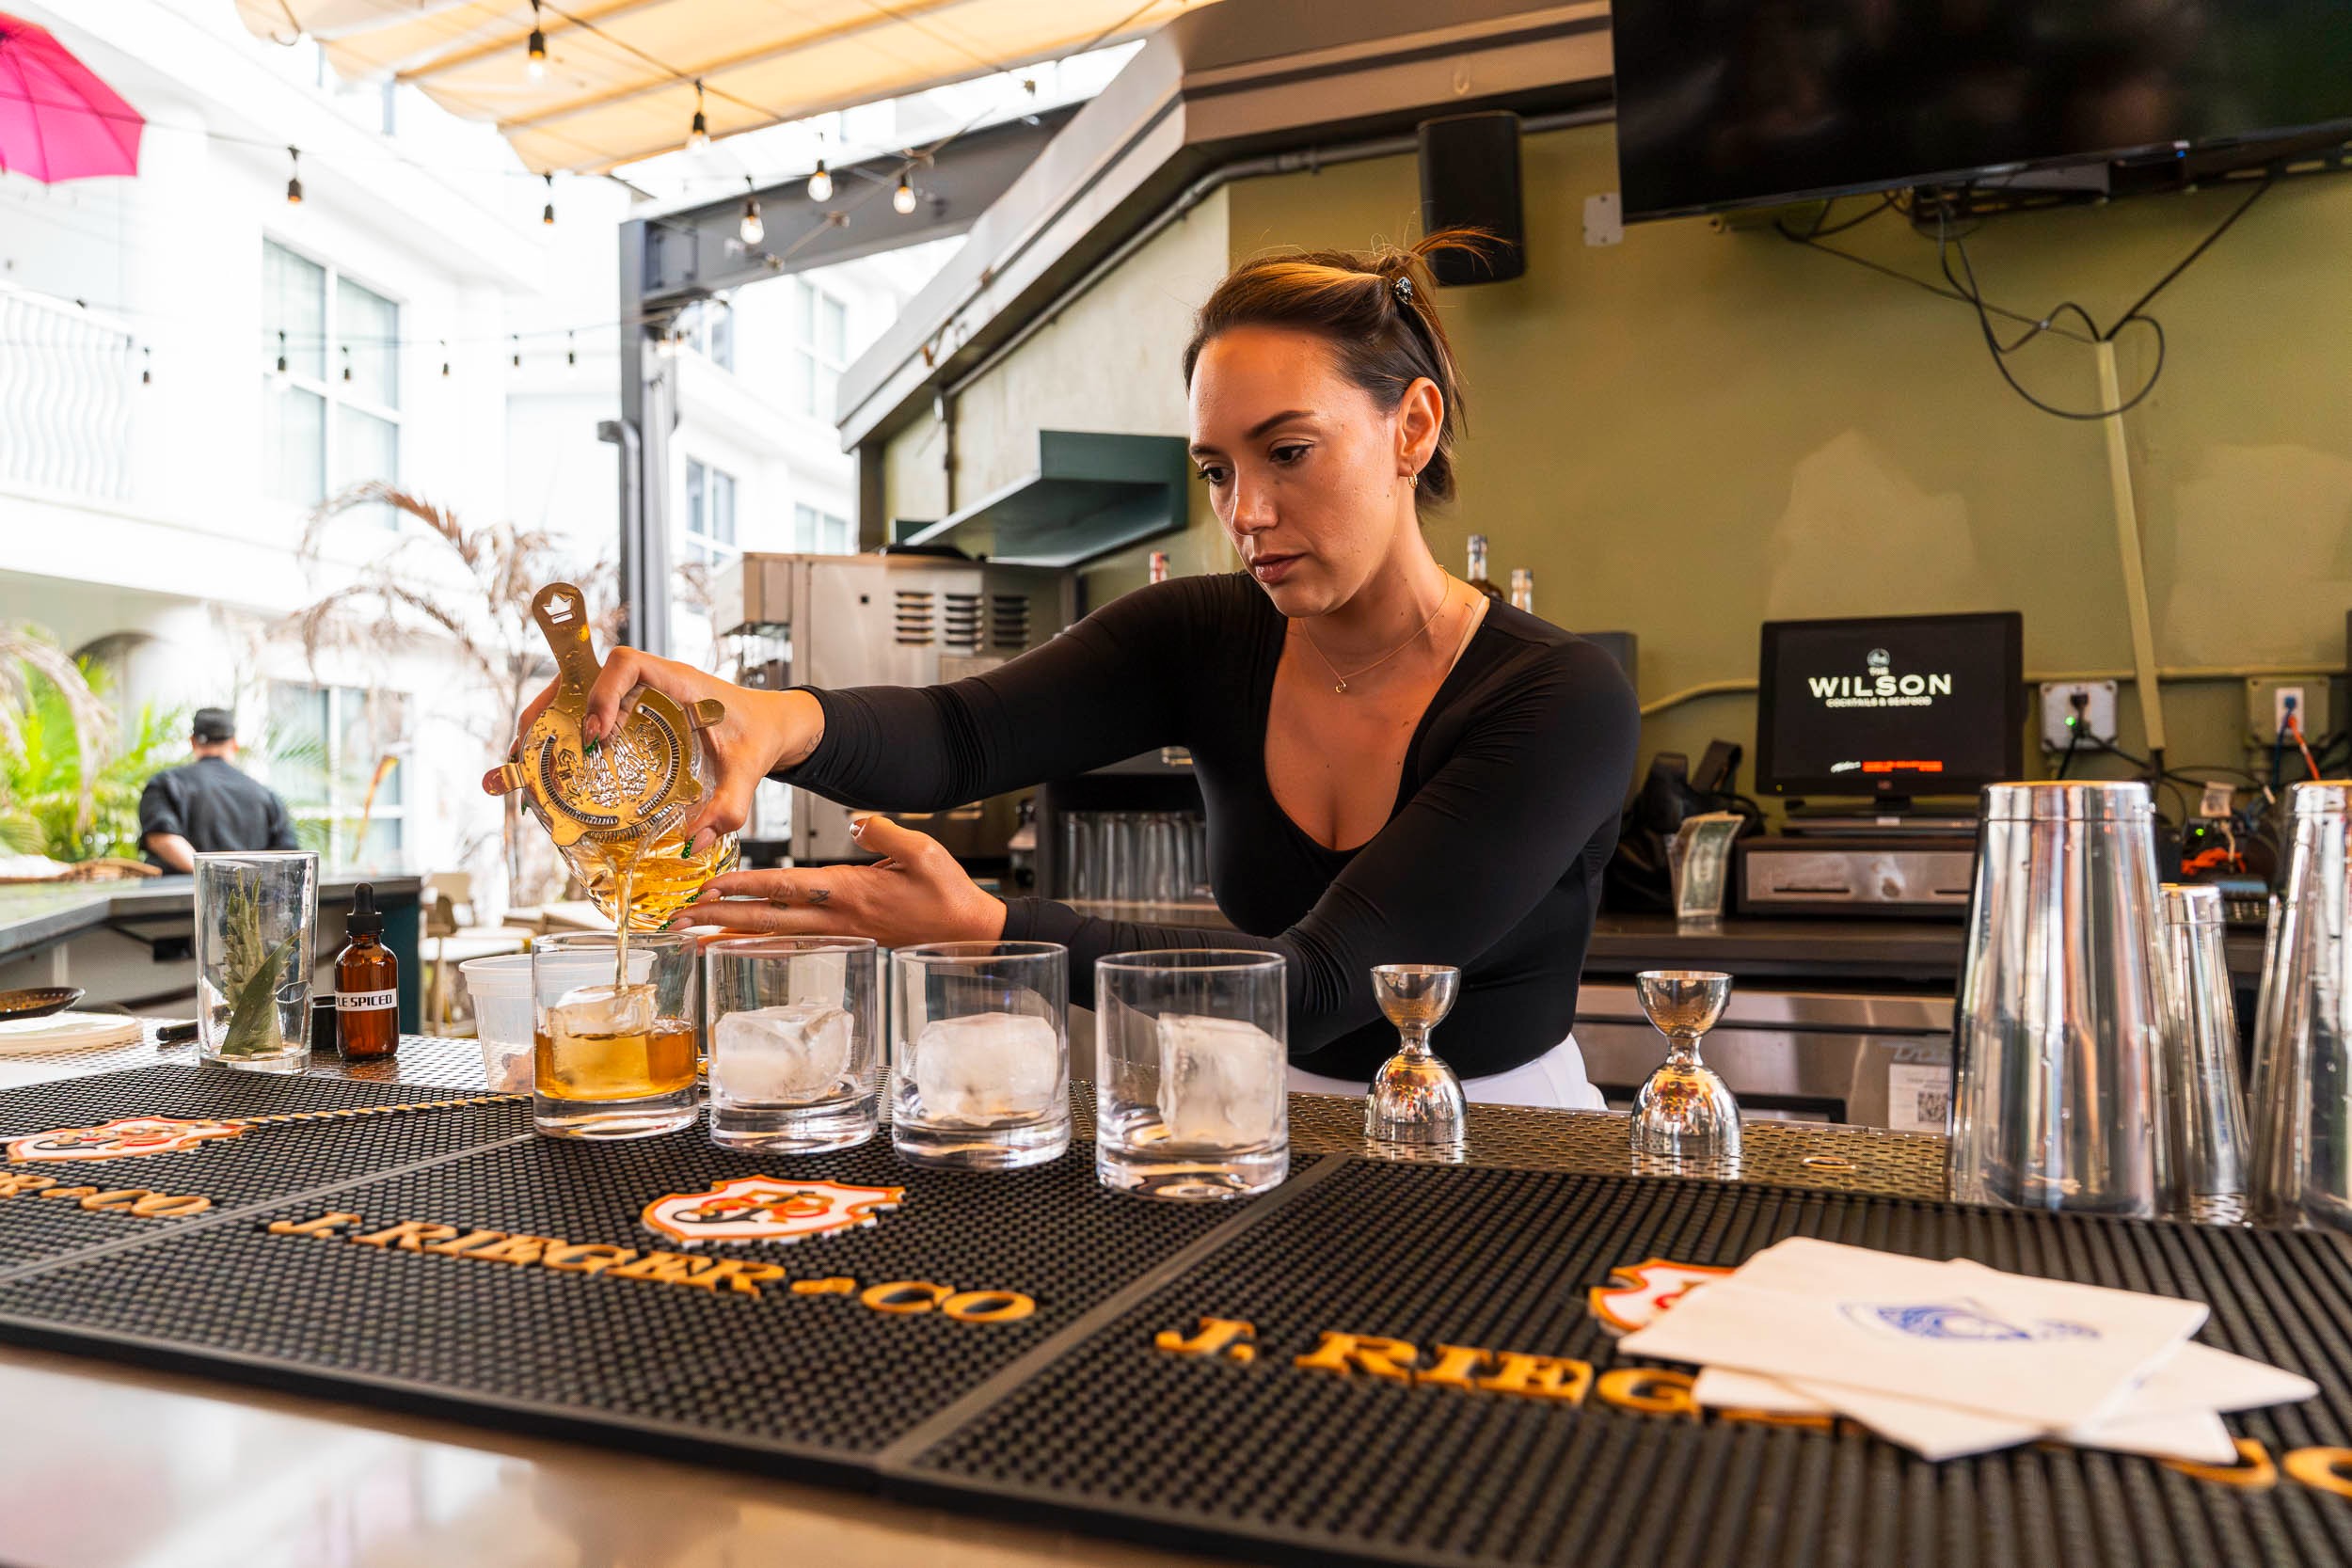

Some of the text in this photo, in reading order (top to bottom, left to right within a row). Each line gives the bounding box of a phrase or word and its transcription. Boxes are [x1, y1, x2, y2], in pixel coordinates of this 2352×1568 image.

[1807, 673, 1952, 698] WILSON
[350, 993, 392, 1007] SPICED
[269, 1212, 361, 1239] J.
[351, 1221, 787, 1298] RIEGER
[860, 1280, 1035, 1323] CO
[1154, 1317, 1256, 1364] J.
